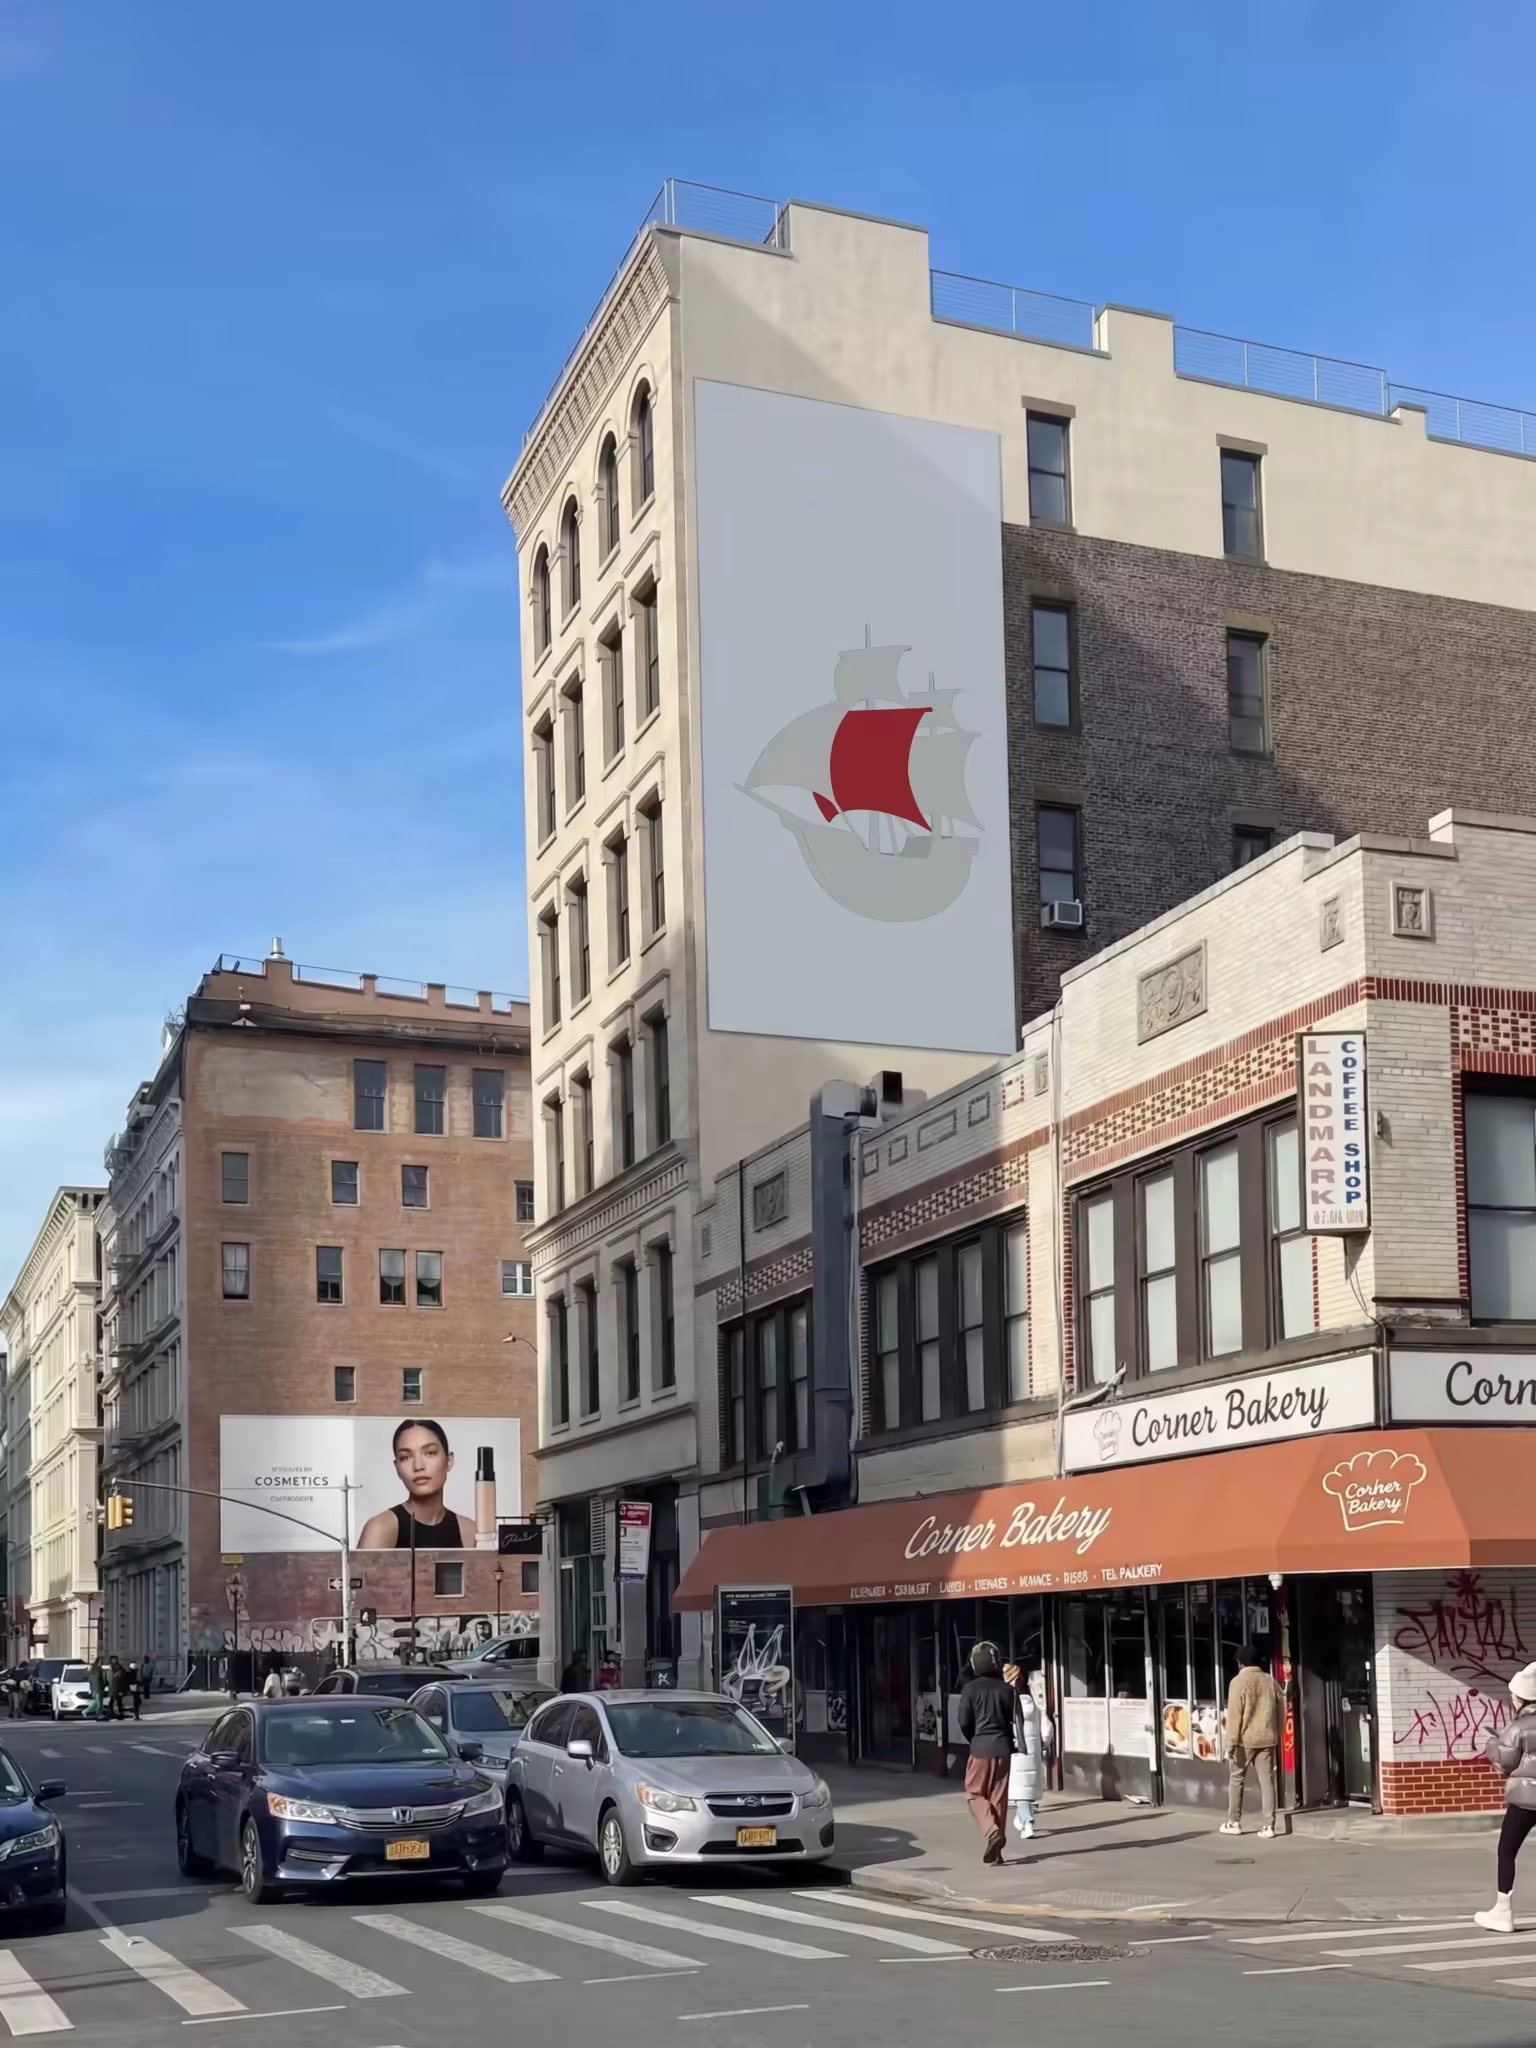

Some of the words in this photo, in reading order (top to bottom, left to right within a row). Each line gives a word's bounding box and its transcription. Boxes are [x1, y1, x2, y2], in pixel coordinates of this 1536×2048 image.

[1341, 1040, 1359, 1131] COFFEE
[1308, 1039, 1335, 1205] LANDMARK
[1344, 1143, 1361, 1204] SHOP
[1132, 1405, 1218, 1447] Corner
[1225, 1381, 1329, 1429] Bakery
[1445, 1361, 1536, 1406] Corn
[255, 1476, 329, 1486] COSMETICS
[1347, 1496, 1402, 1514] Bakery
[904, 1516, 997, 1559] Corner
[999, 1496, 1113, 1554] Bakery
